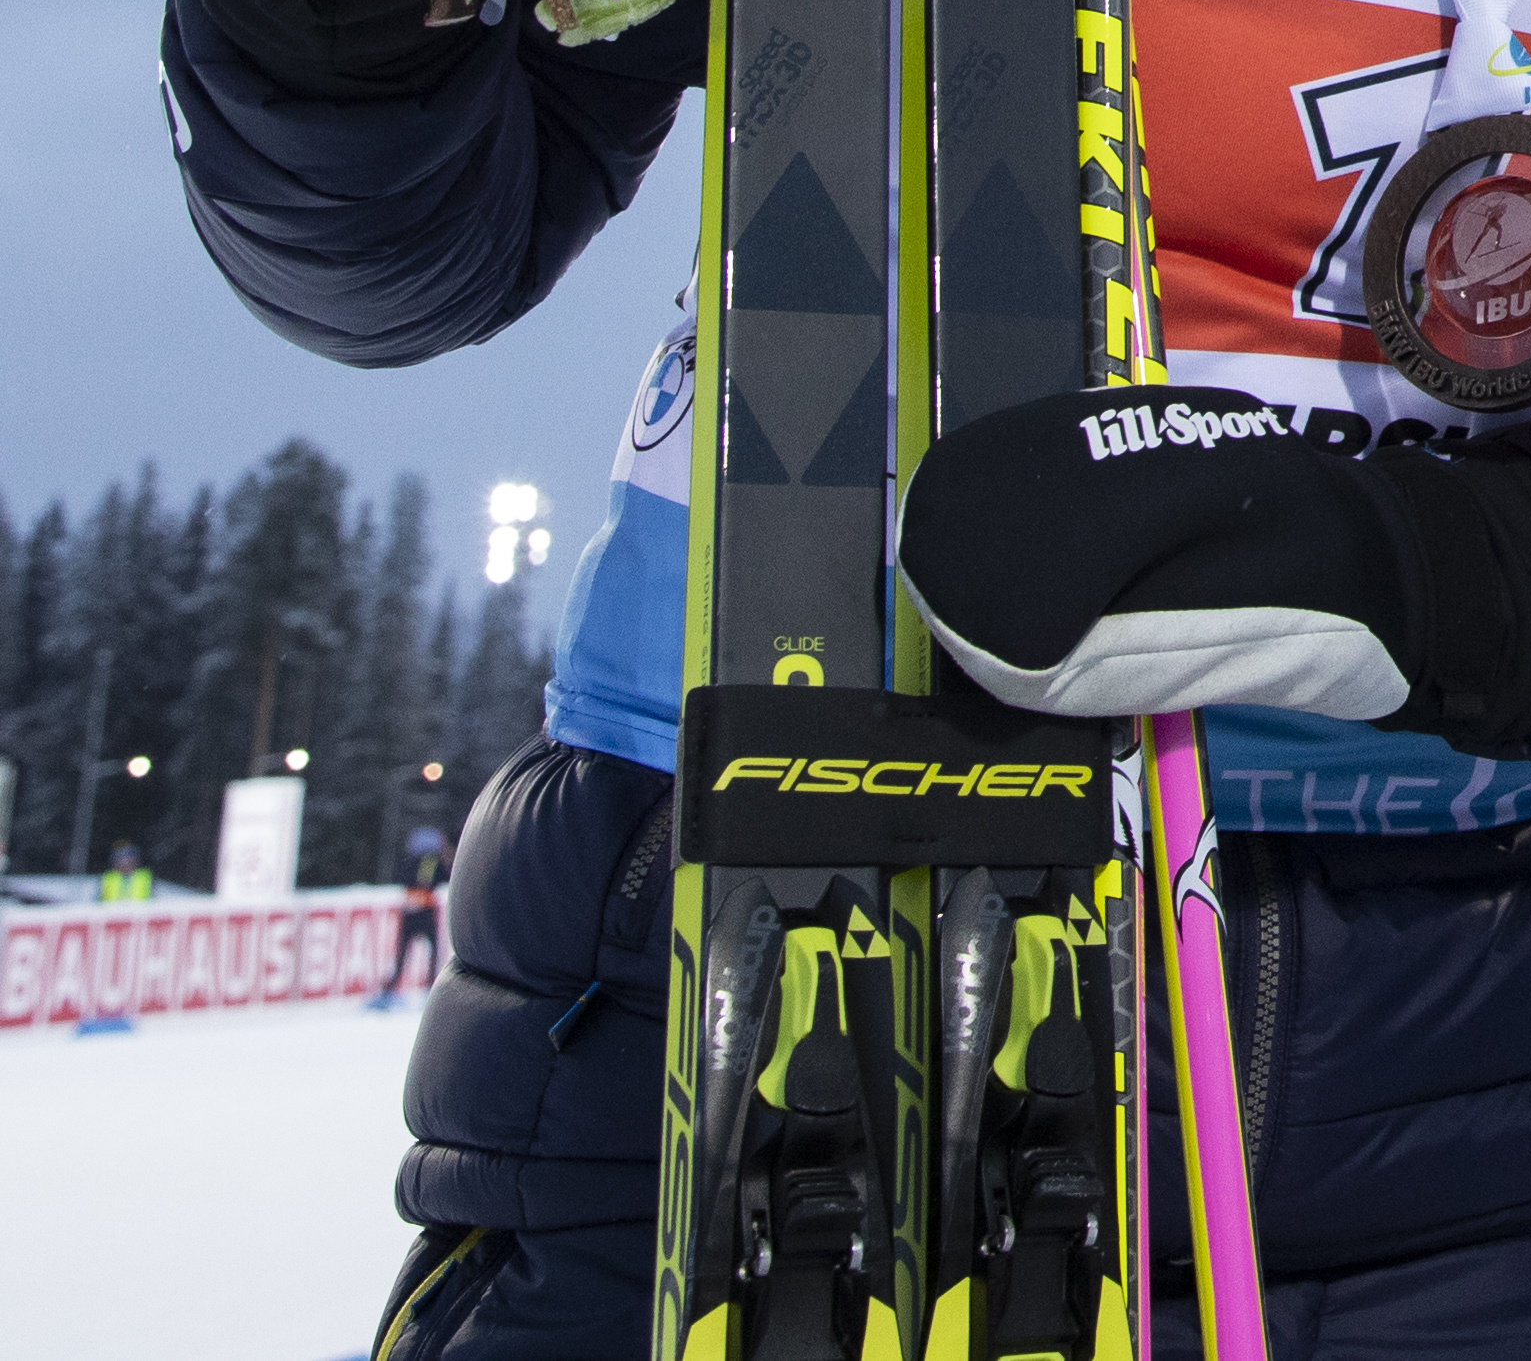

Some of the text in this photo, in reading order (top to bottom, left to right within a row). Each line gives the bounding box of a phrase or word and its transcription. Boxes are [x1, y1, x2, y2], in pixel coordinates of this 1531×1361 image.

[774, 636, 824, 651] GLIDE
[712, 757, 1093, 798] FISCHER
[1221, 767, 1439, 834] THE
